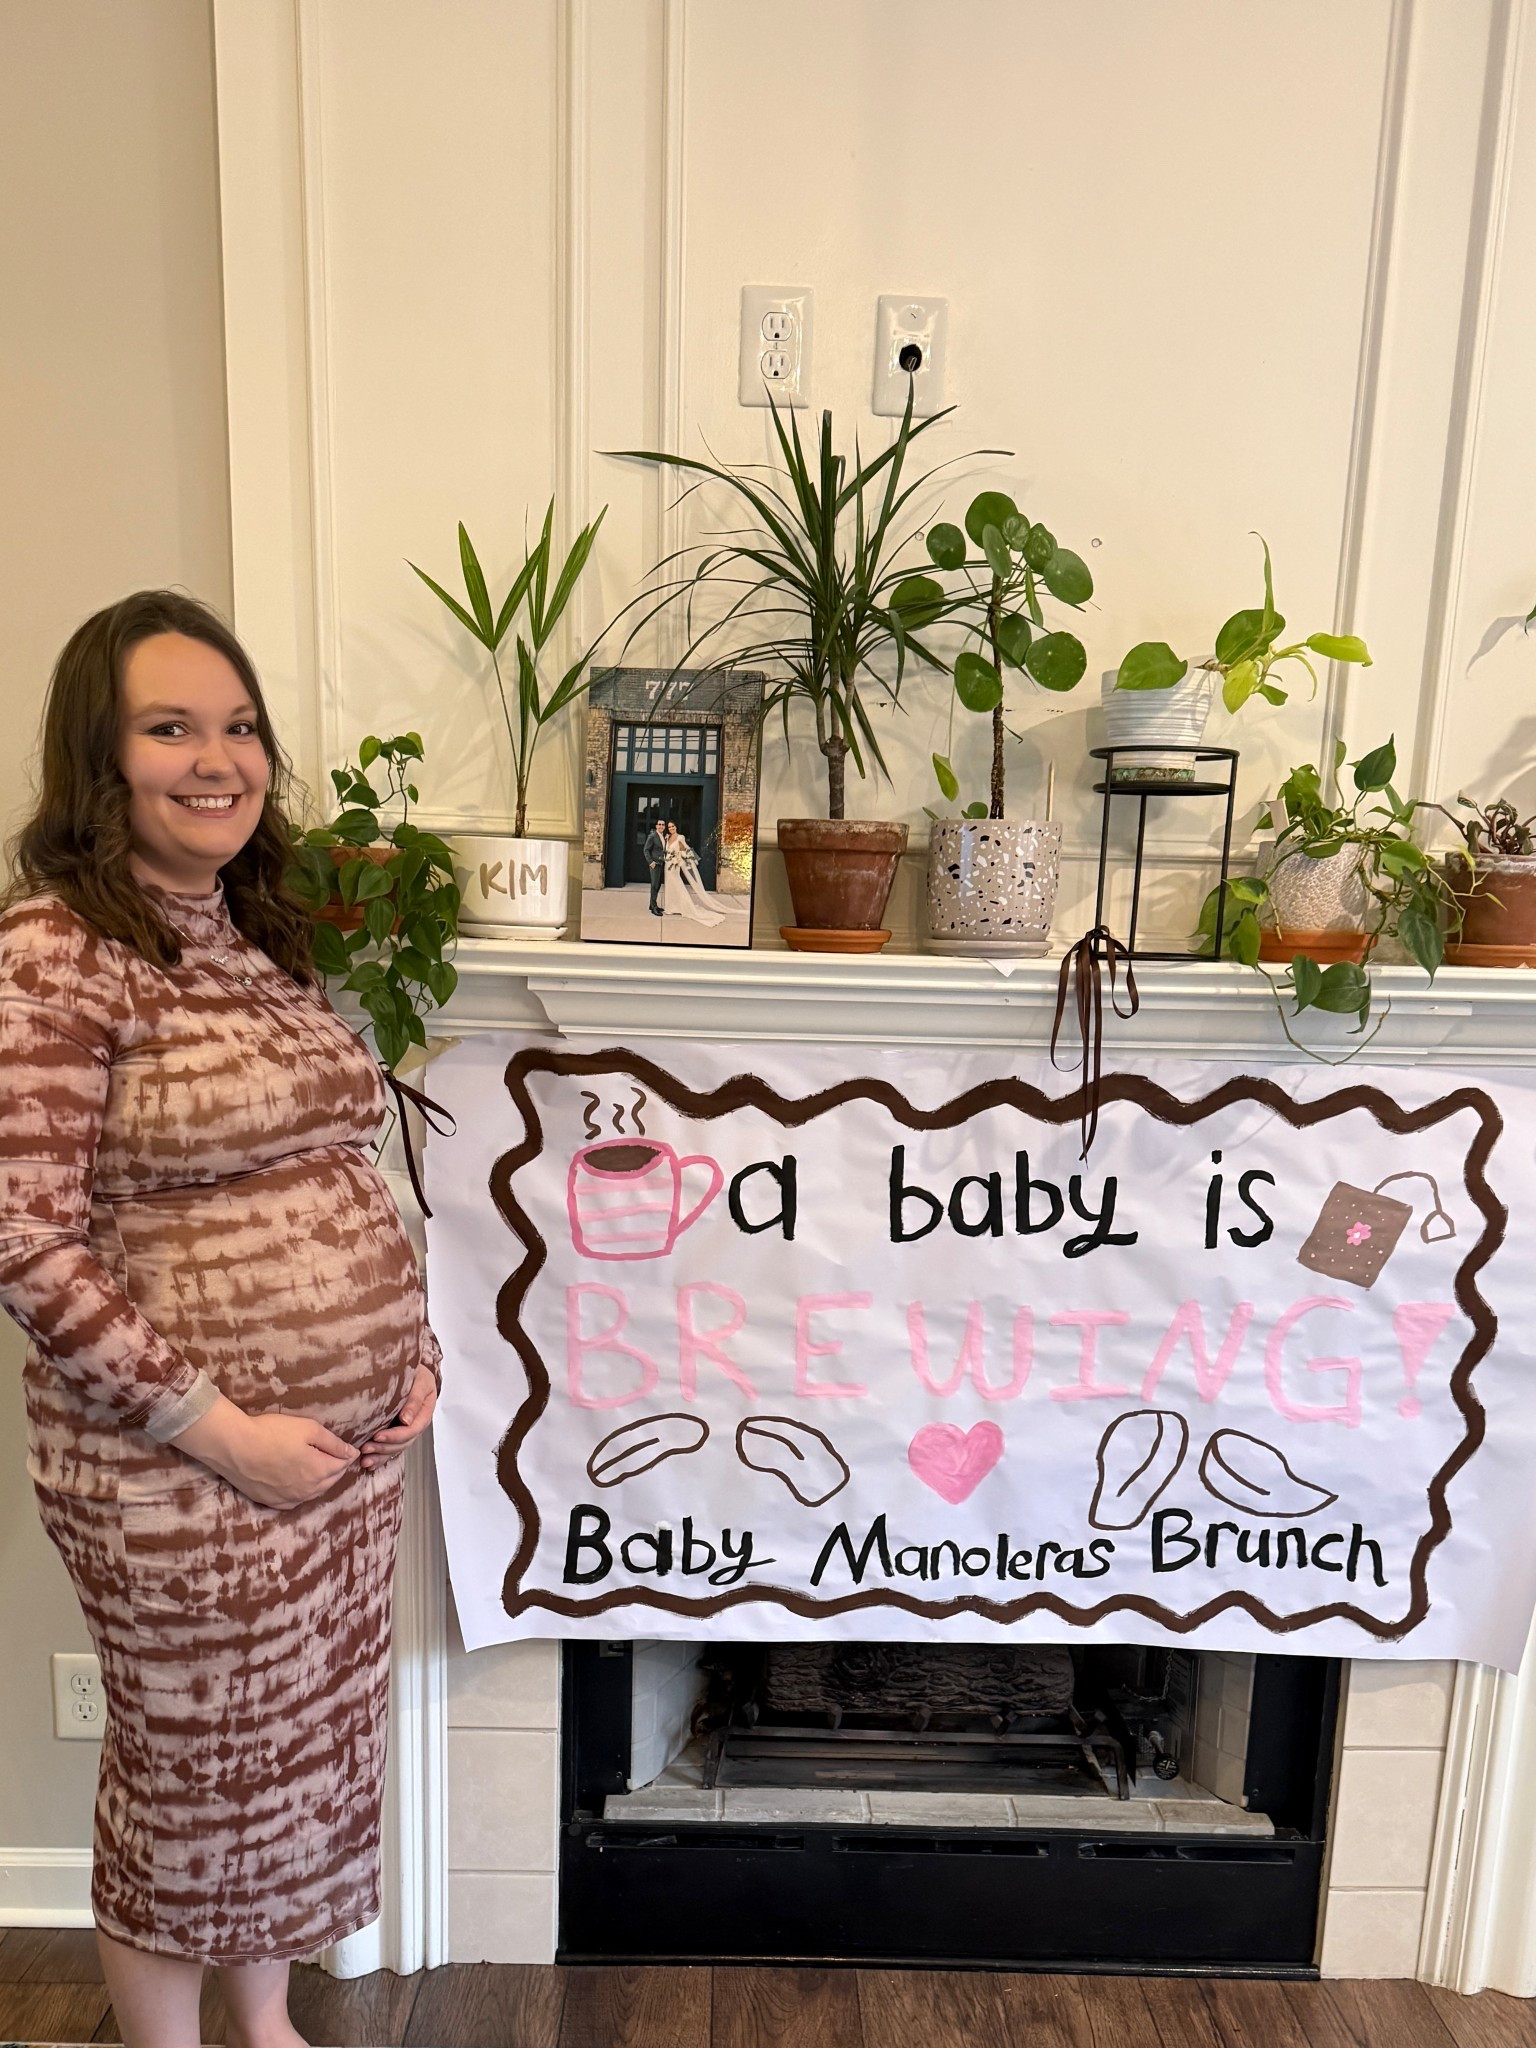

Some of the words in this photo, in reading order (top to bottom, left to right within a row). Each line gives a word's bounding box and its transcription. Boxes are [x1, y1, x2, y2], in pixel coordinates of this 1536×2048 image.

[645, 679, 693, 702] 777
[479, 860, 548, 900] KIM
[728, 1155, 797, 1240] a
[889, 1144, 1139, 1259] baby
[1204, 1150, 1275, 1249] is
[565, 1282, 1456, 1429] BREWING!
[562, 1504, 776, 1586] Baby
[810, 1513, 1116, 1587] Manoleras
[1151, 1508, 1389, 1586] Brunch
